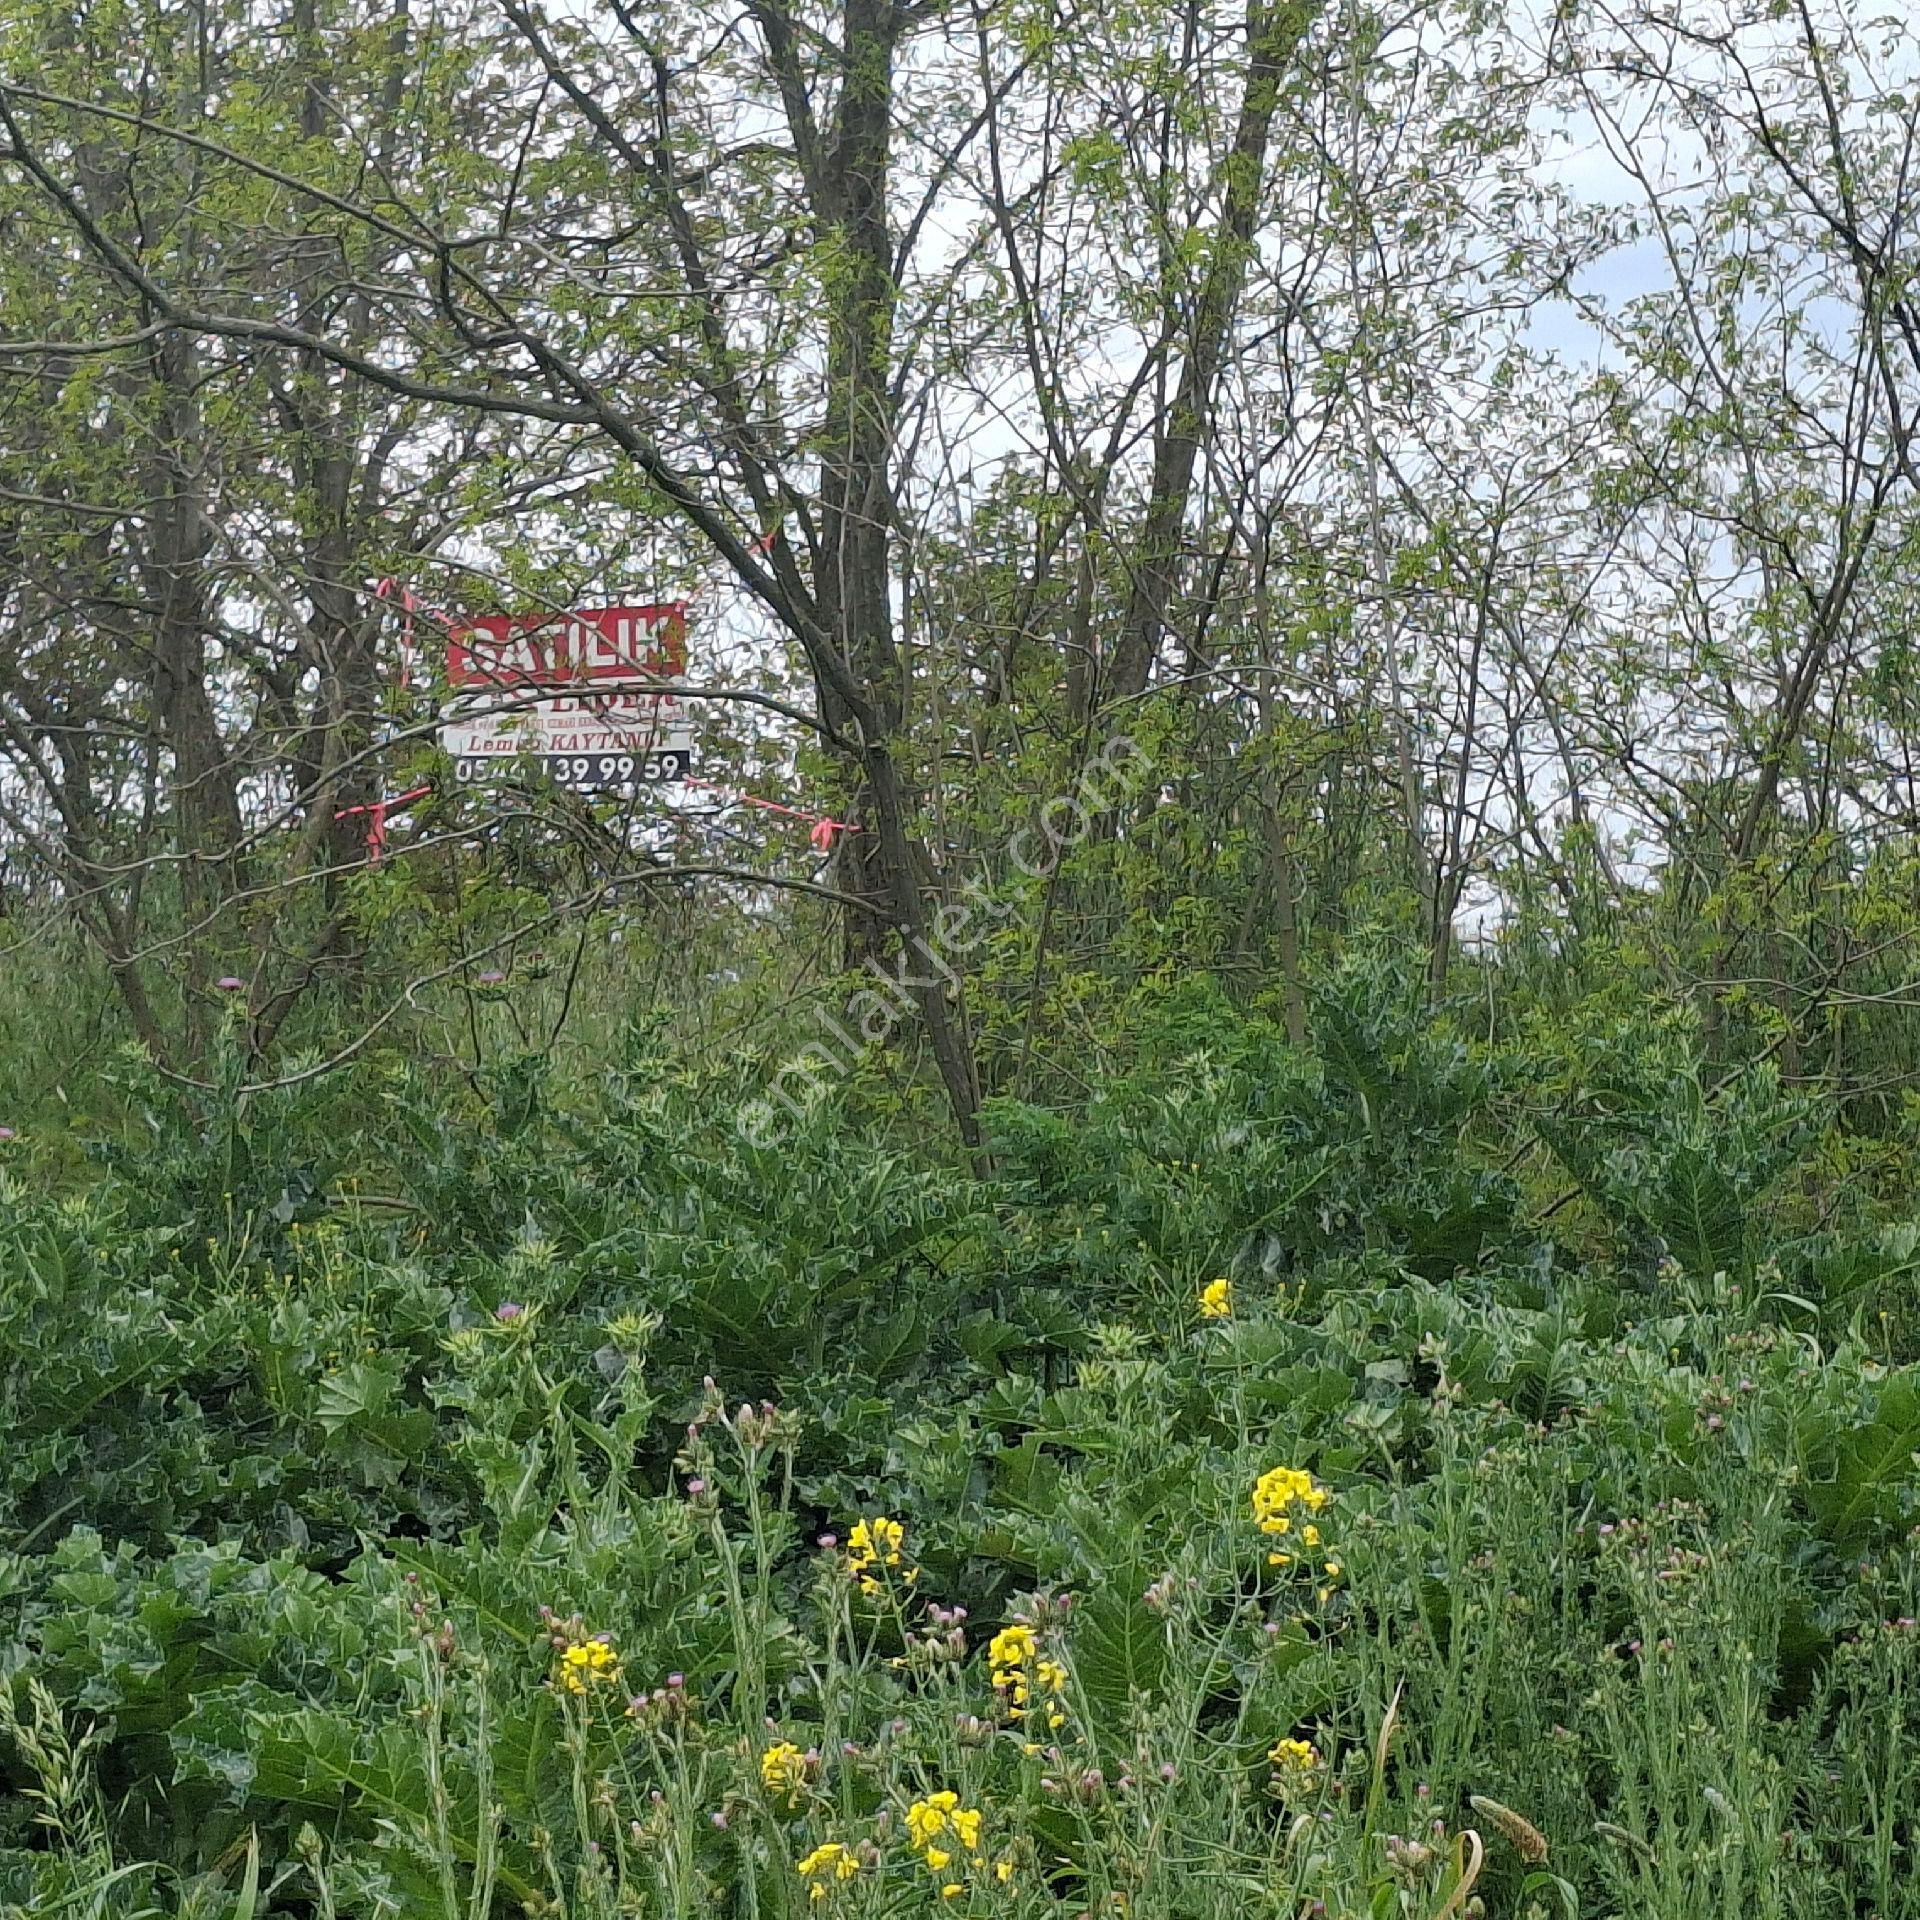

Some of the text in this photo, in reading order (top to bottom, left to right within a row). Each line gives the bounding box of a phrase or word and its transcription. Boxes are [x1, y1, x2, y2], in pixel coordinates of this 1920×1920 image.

[461, 616, 678, 673] SATILIK
[599, 757, 635, 780] 99
[644, 755, 679, 779] 59
